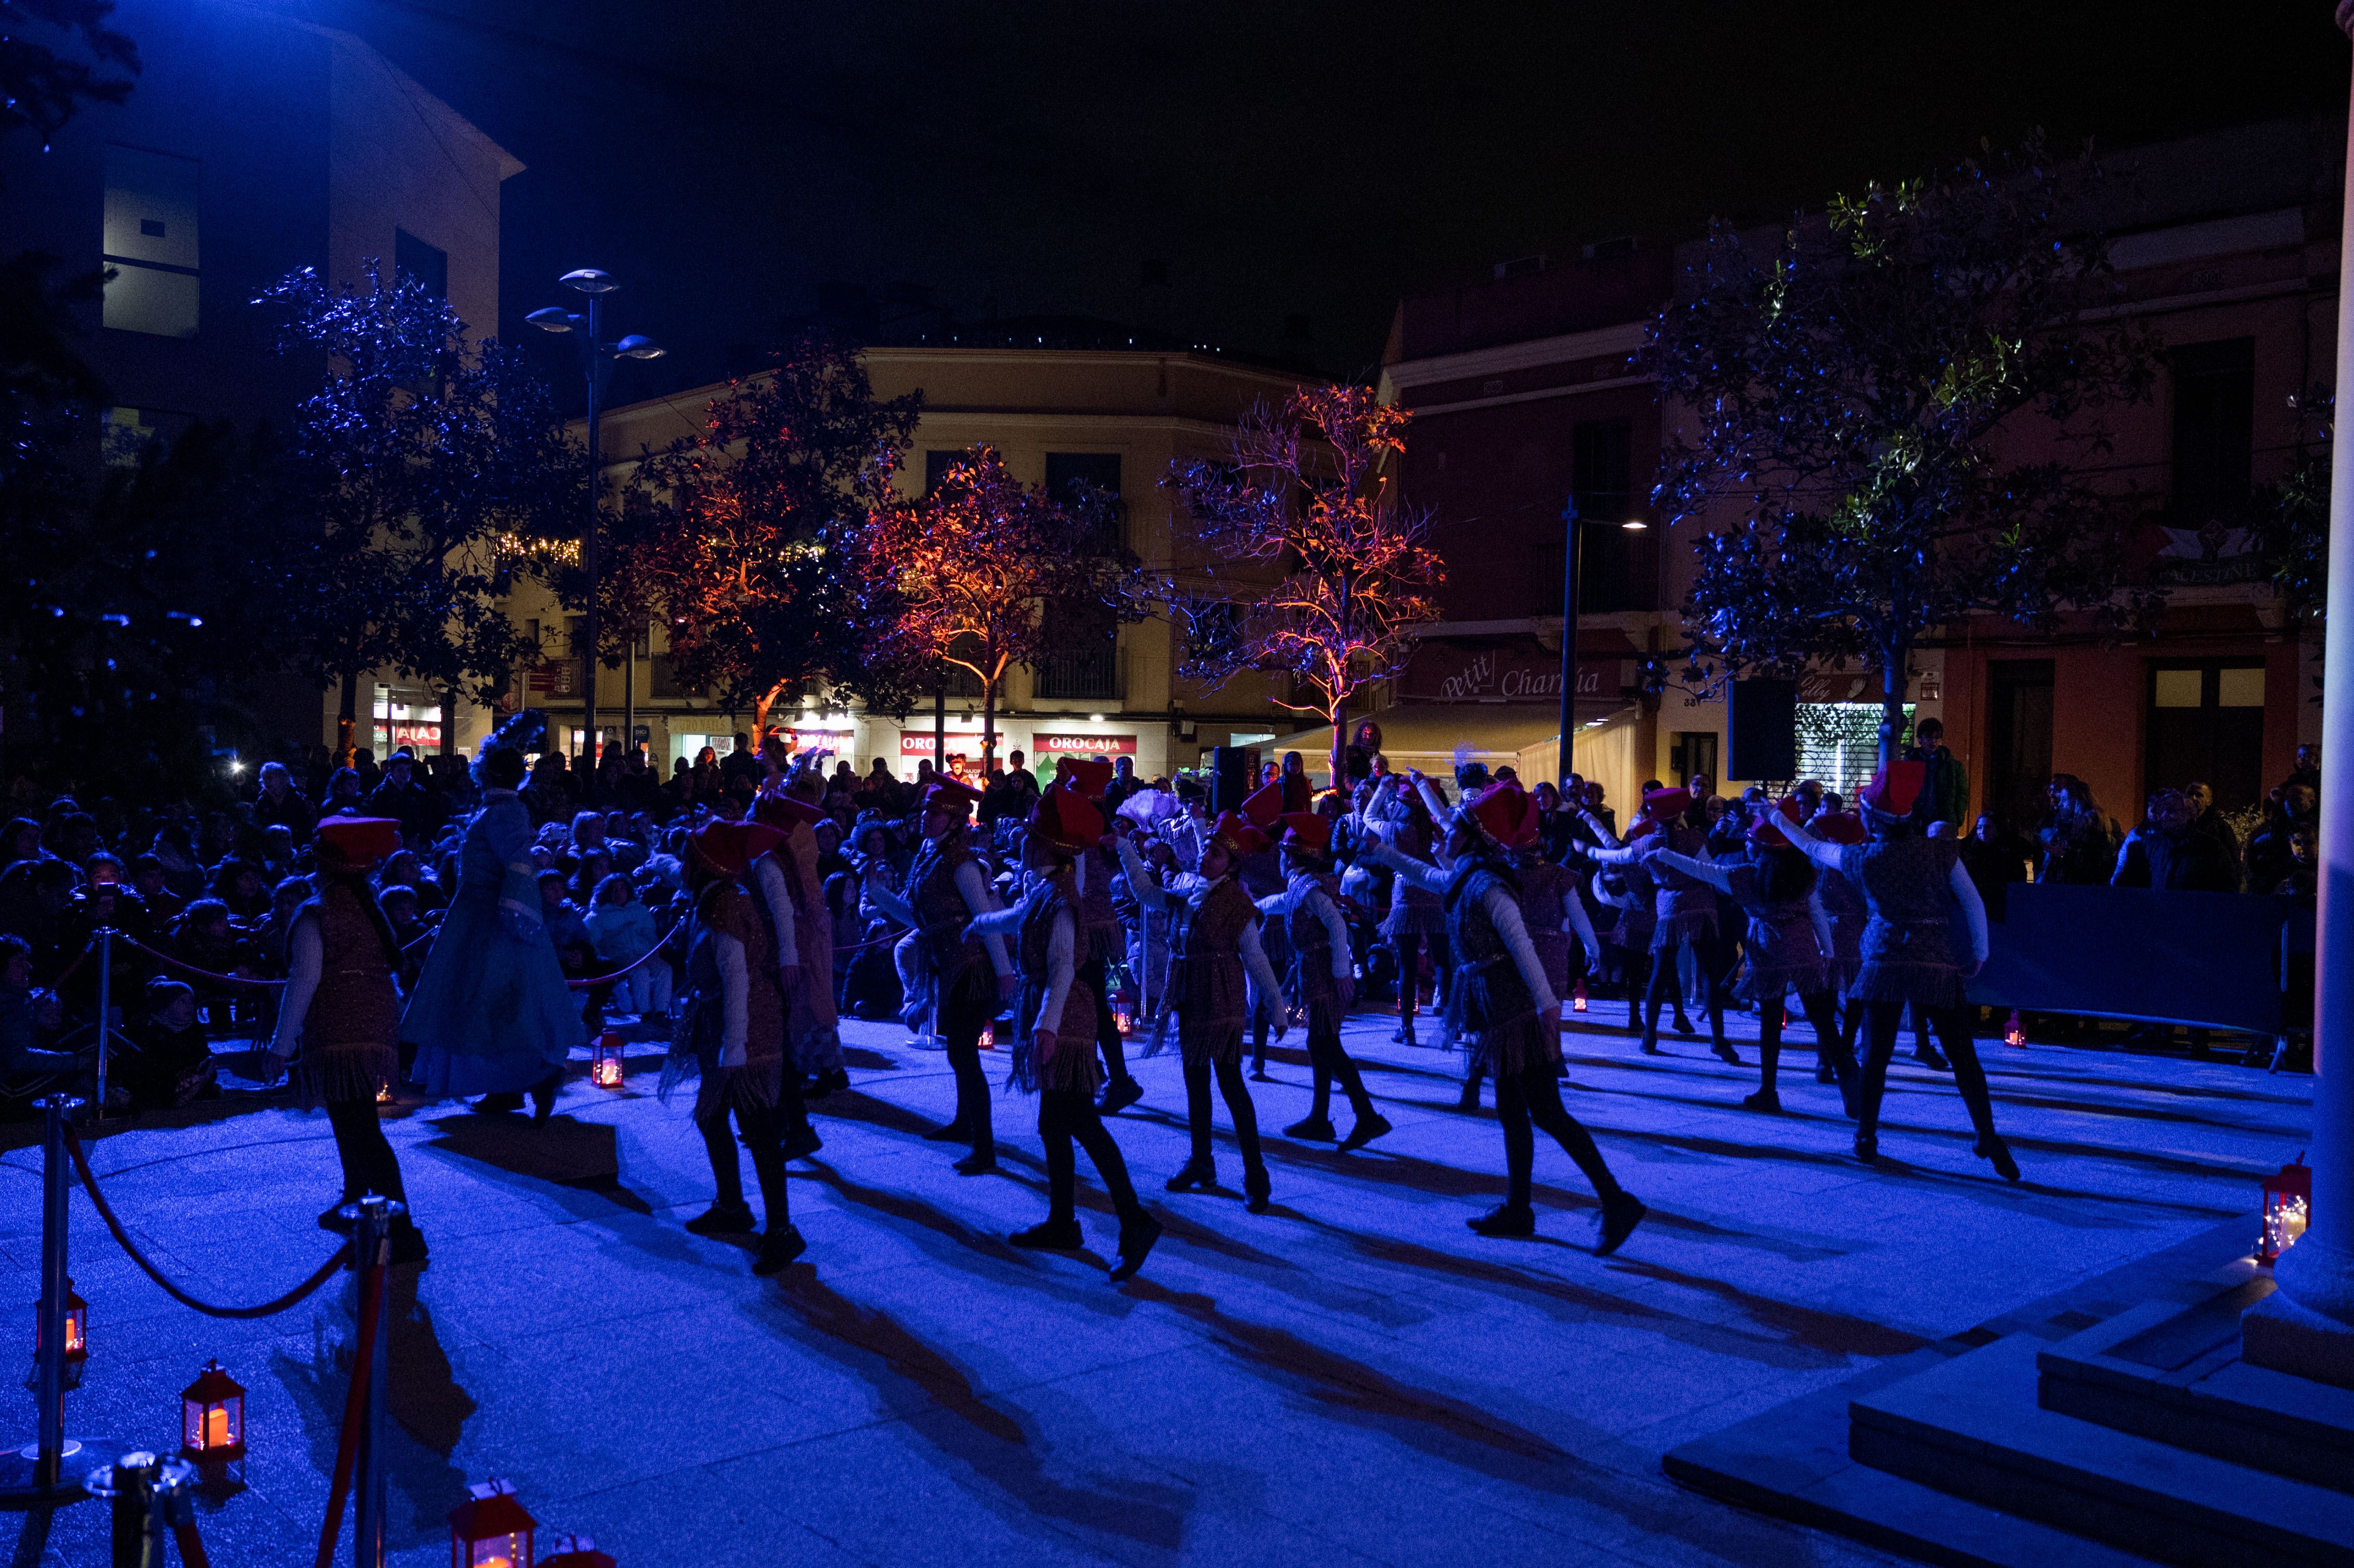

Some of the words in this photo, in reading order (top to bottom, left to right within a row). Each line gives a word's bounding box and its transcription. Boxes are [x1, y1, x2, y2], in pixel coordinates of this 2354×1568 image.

[1441, 654, 1491, 705] Petit
[1501, 668, 1600, 696] Charía
[1049, 737, 1121, 751] OROCAJA
